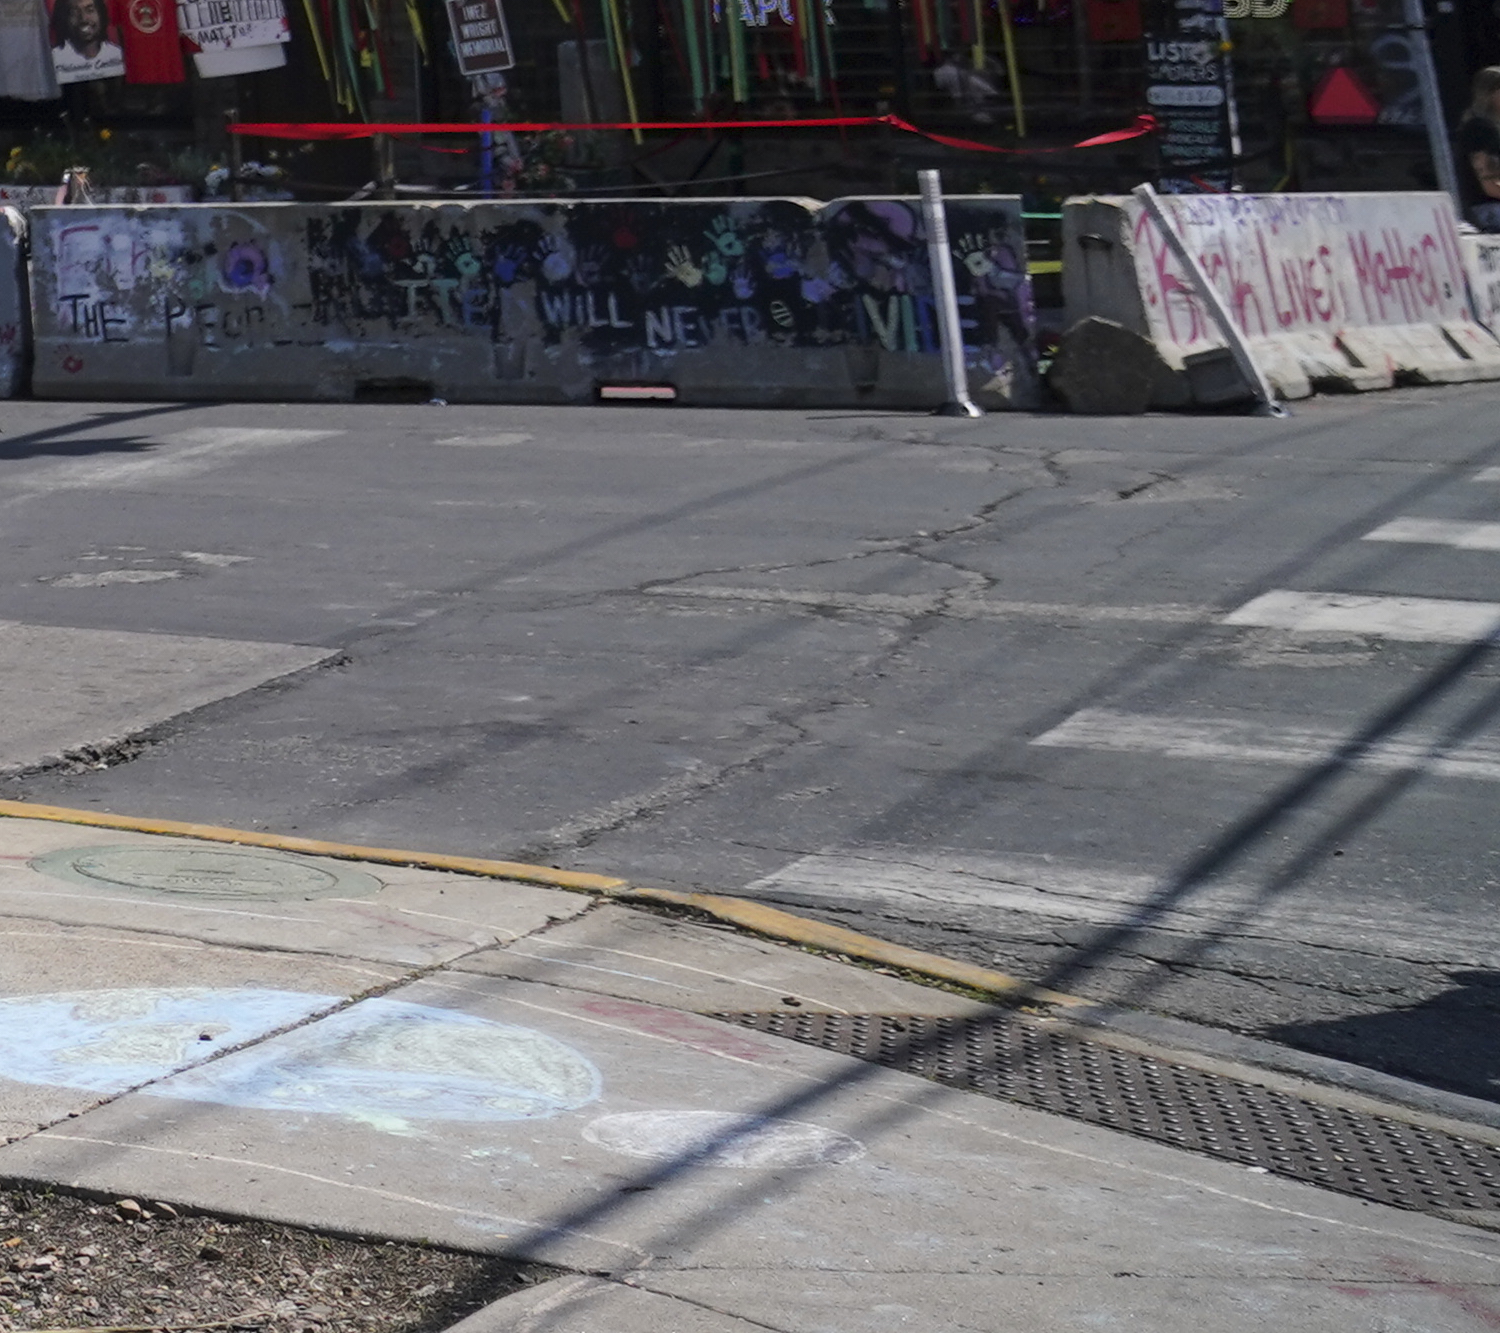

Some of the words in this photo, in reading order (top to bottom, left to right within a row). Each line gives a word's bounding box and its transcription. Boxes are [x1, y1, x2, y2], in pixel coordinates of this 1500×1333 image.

[458, 36, 507, 60] MEMORIAL
[58, 293, 130, 344] THE
[540, 289, 634, 329] WILL
